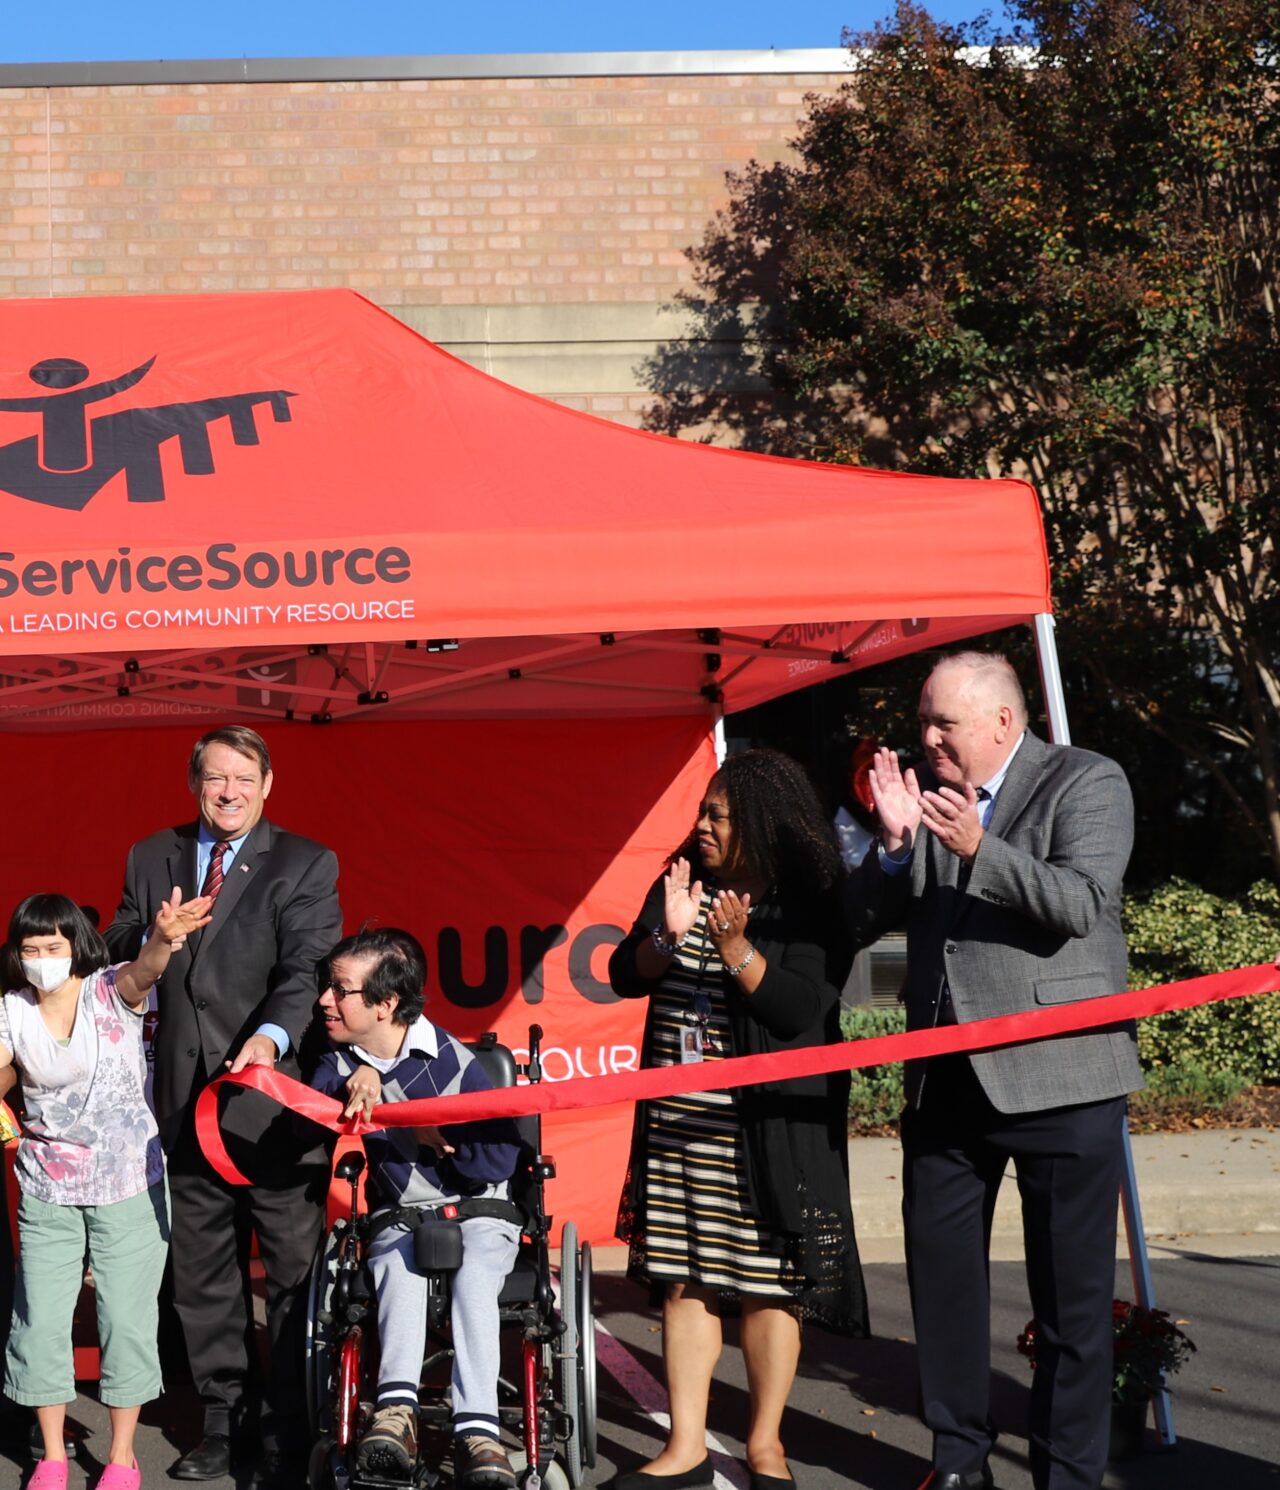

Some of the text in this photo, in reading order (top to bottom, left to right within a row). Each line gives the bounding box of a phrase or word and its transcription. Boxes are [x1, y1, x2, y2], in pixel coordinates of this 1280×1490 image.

[10, 610, 118, 633] LEADING
[125, 605, 282, 629] COMMUNITY
[287, 599, 416, 623] RESOURCE
